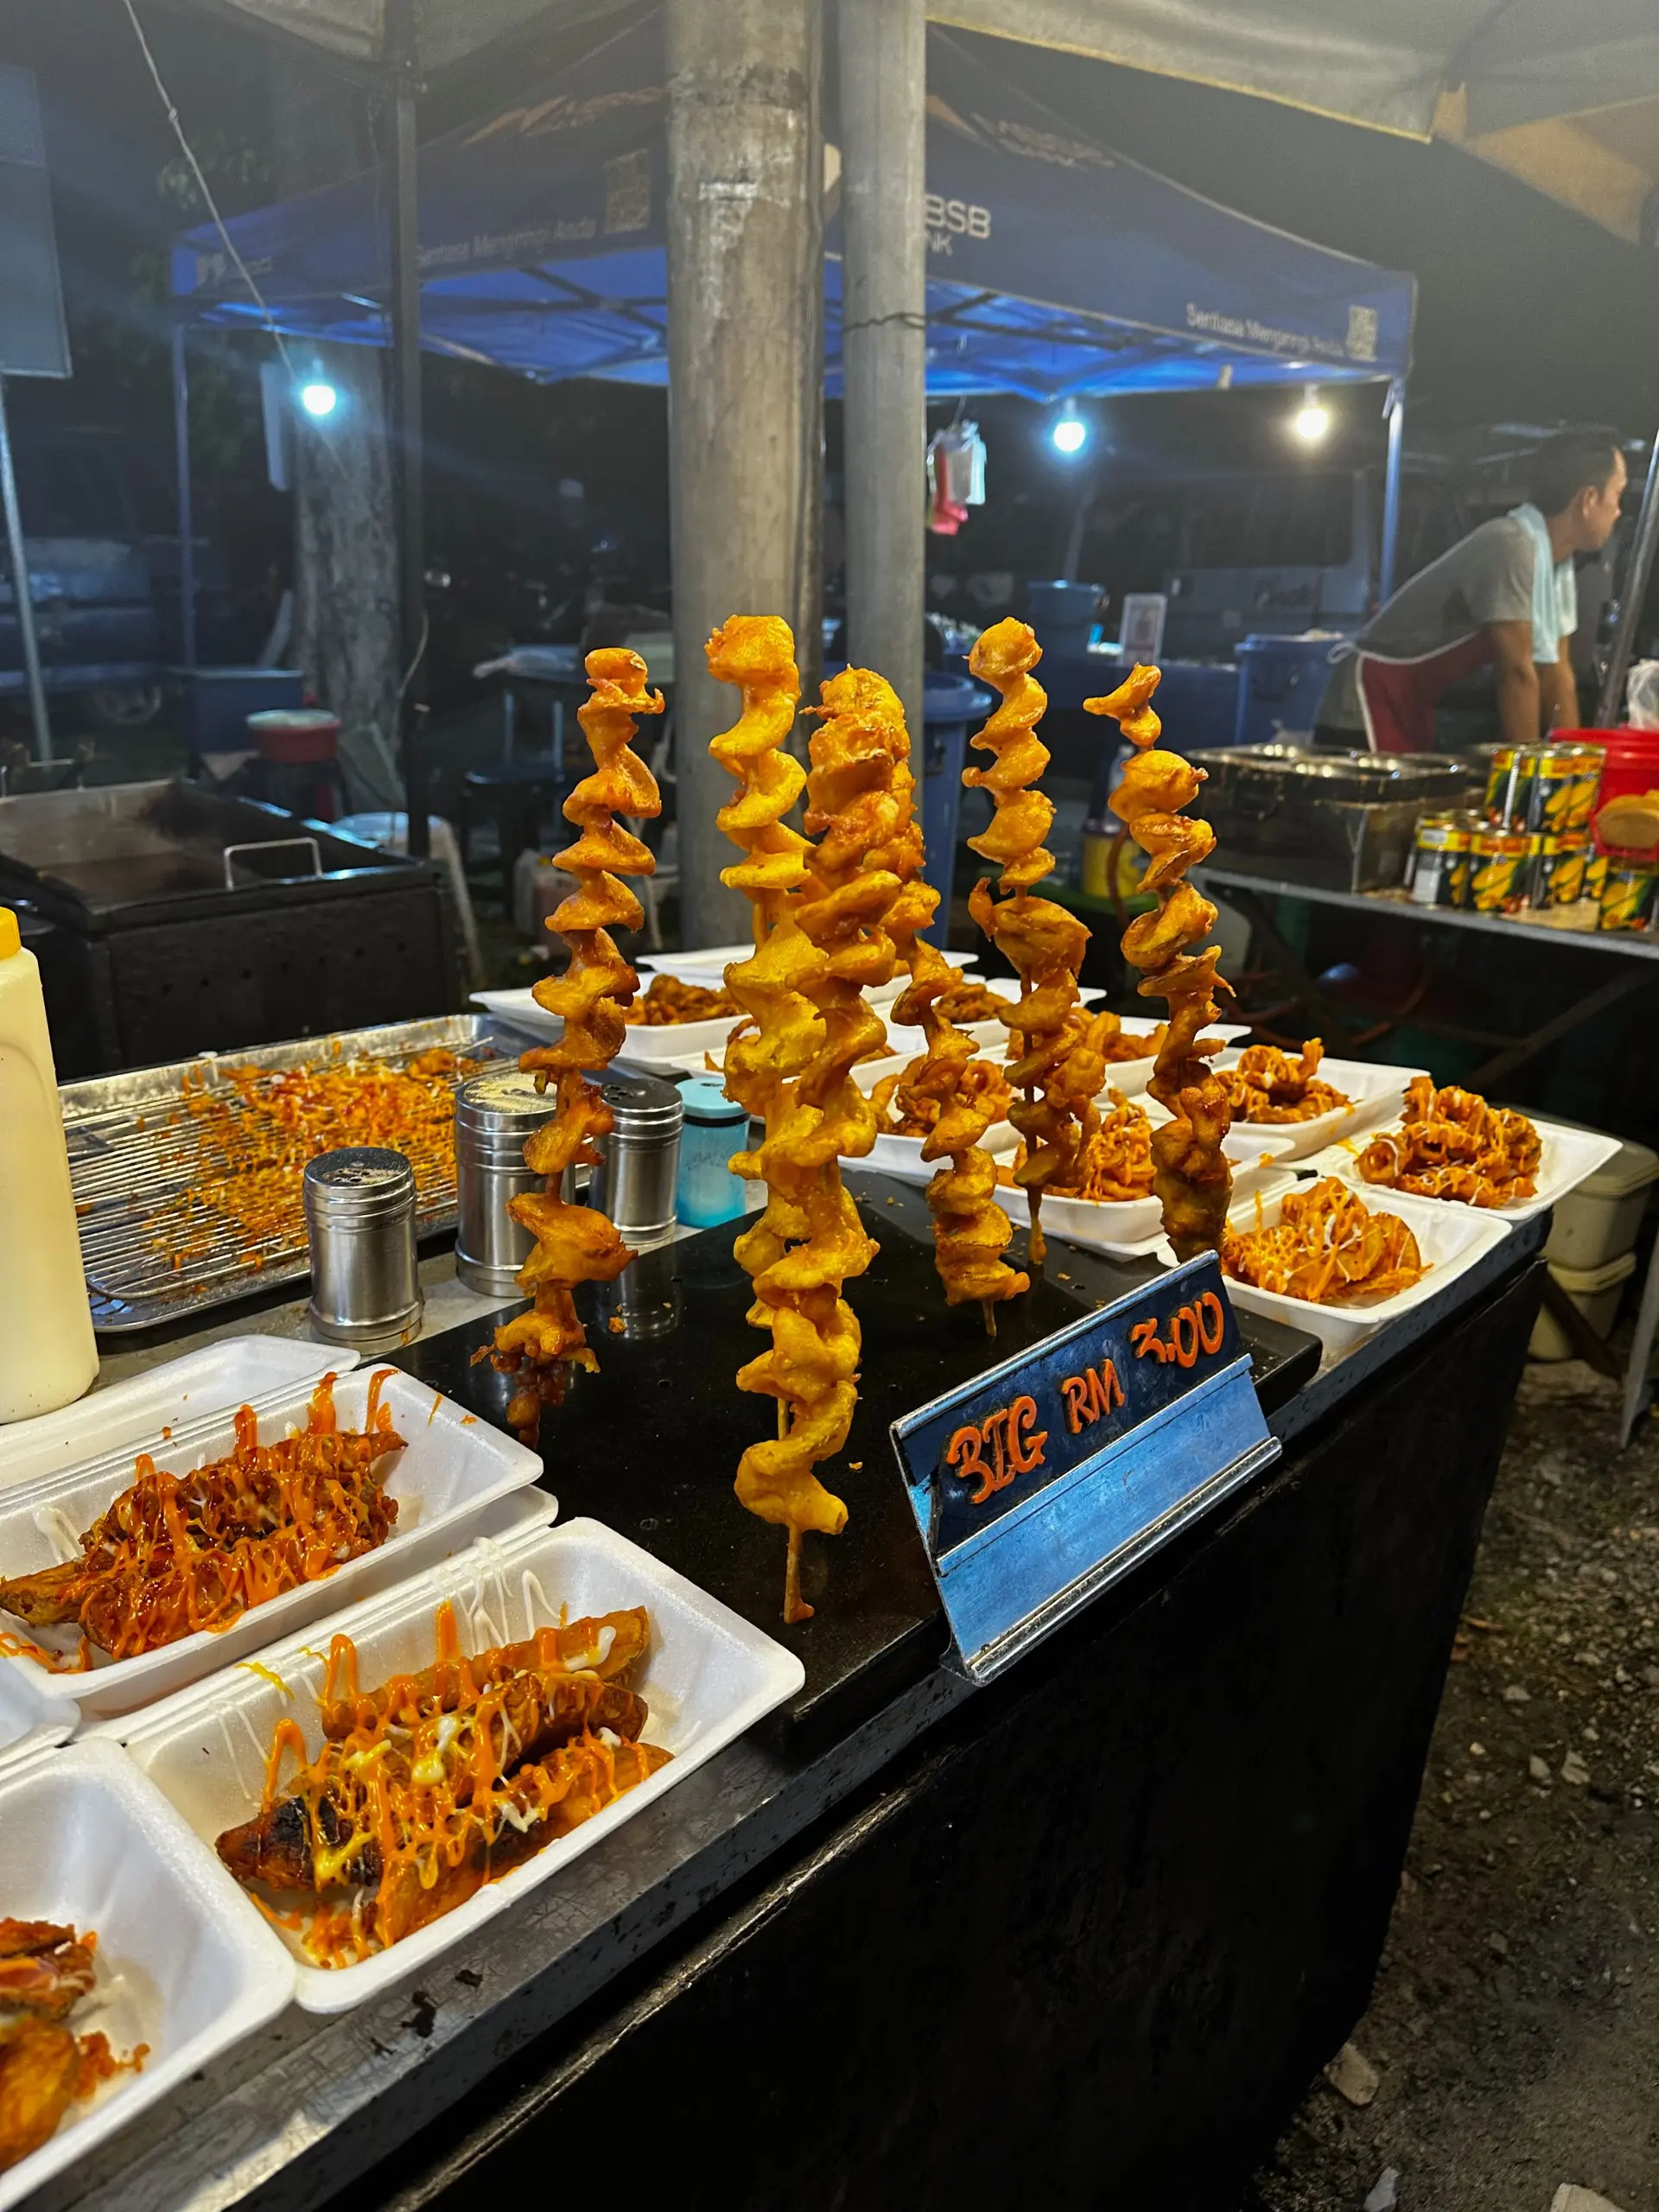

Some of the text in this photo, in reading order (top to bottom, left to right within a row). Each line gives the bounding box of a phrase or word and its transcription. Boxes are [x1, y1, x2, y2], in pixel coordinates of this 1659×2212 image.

[923, 194, 991, 239] BSB
[947, 1291, 1224, 1504] BIG RM 3.00
